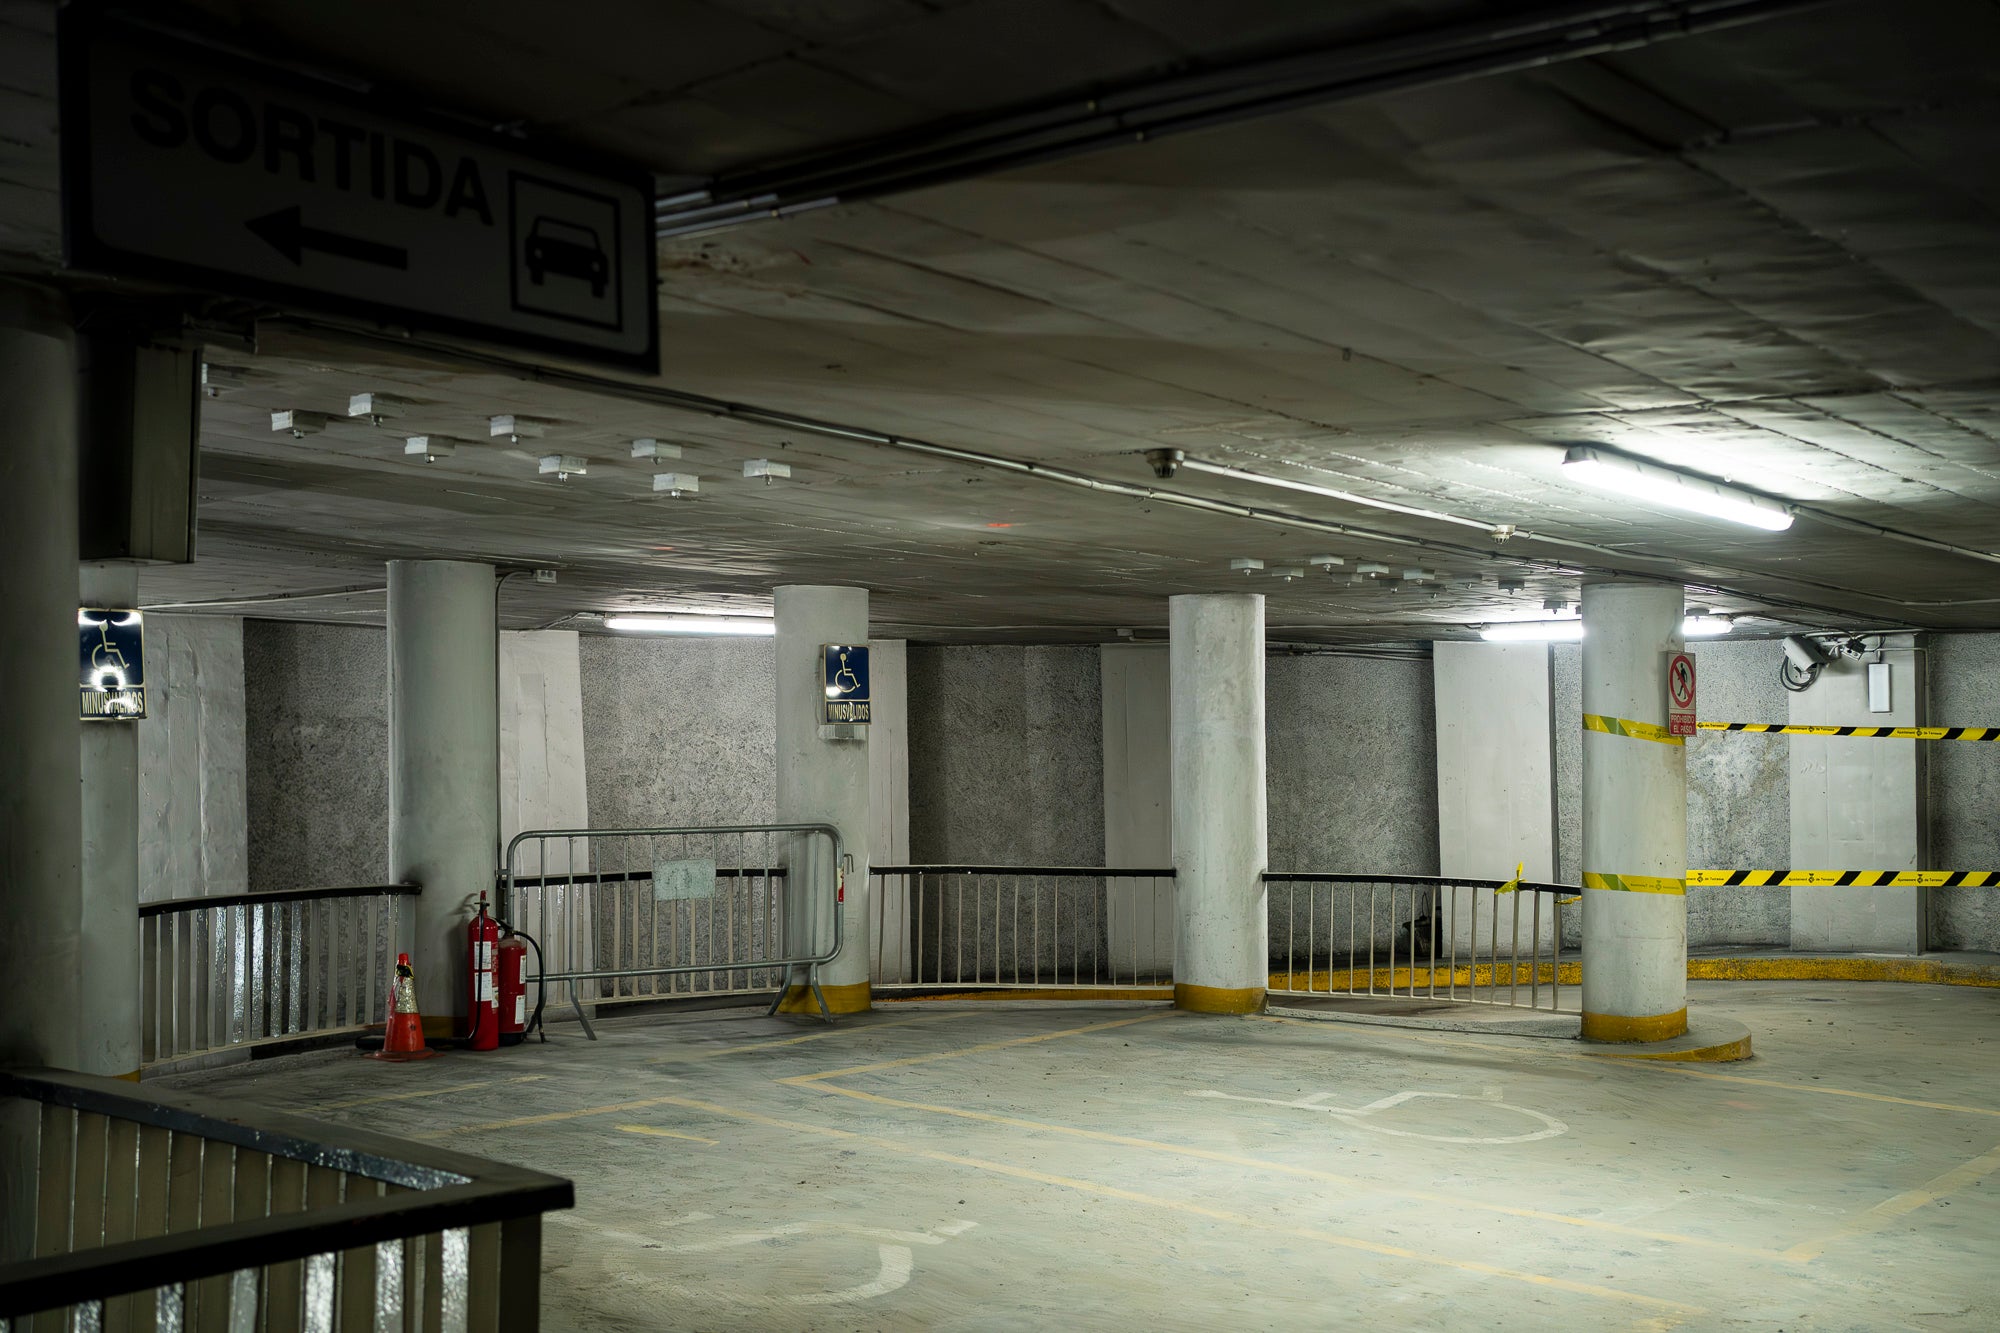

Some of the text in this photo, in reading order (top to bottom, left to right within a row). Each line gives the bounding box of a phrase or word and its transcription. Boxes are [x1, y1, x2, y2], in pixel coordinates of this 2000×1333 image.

[129, 68, 493, 226] SORTIDA
[1671, 714, 1695, 723] PROHIBIDO
[1673, 725, 1679, 733] EL
[1680, 725, 1693, 733] PASO
